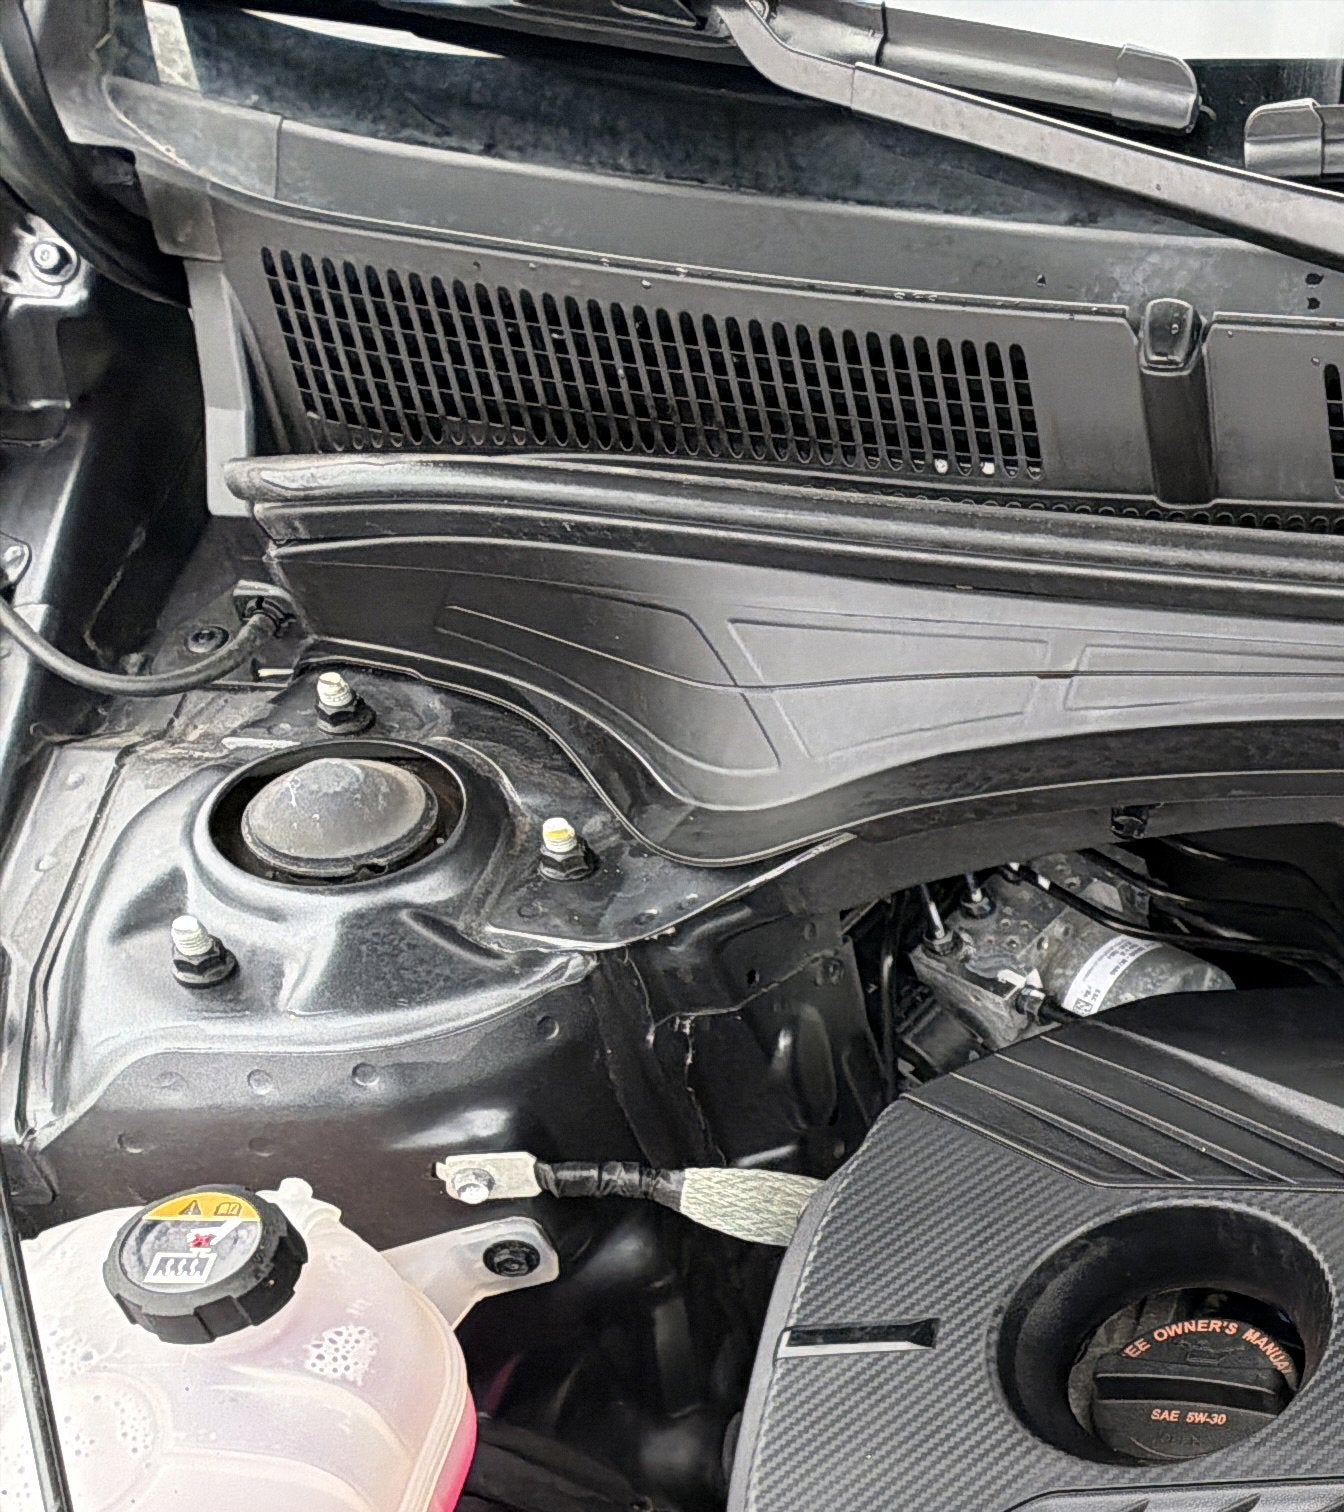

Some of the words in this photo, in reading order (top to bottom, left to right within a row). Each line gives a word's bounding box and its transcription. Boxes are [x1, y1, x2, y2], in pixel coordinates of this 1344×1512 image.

[1121, 1337, 1152, 1359] EE
[1153, 1319, 1240, 1342] OWNER'S
[1150, 1408, 1181, 1423] SAE
[1185, 1410, 1227, 1426] 5W-30
